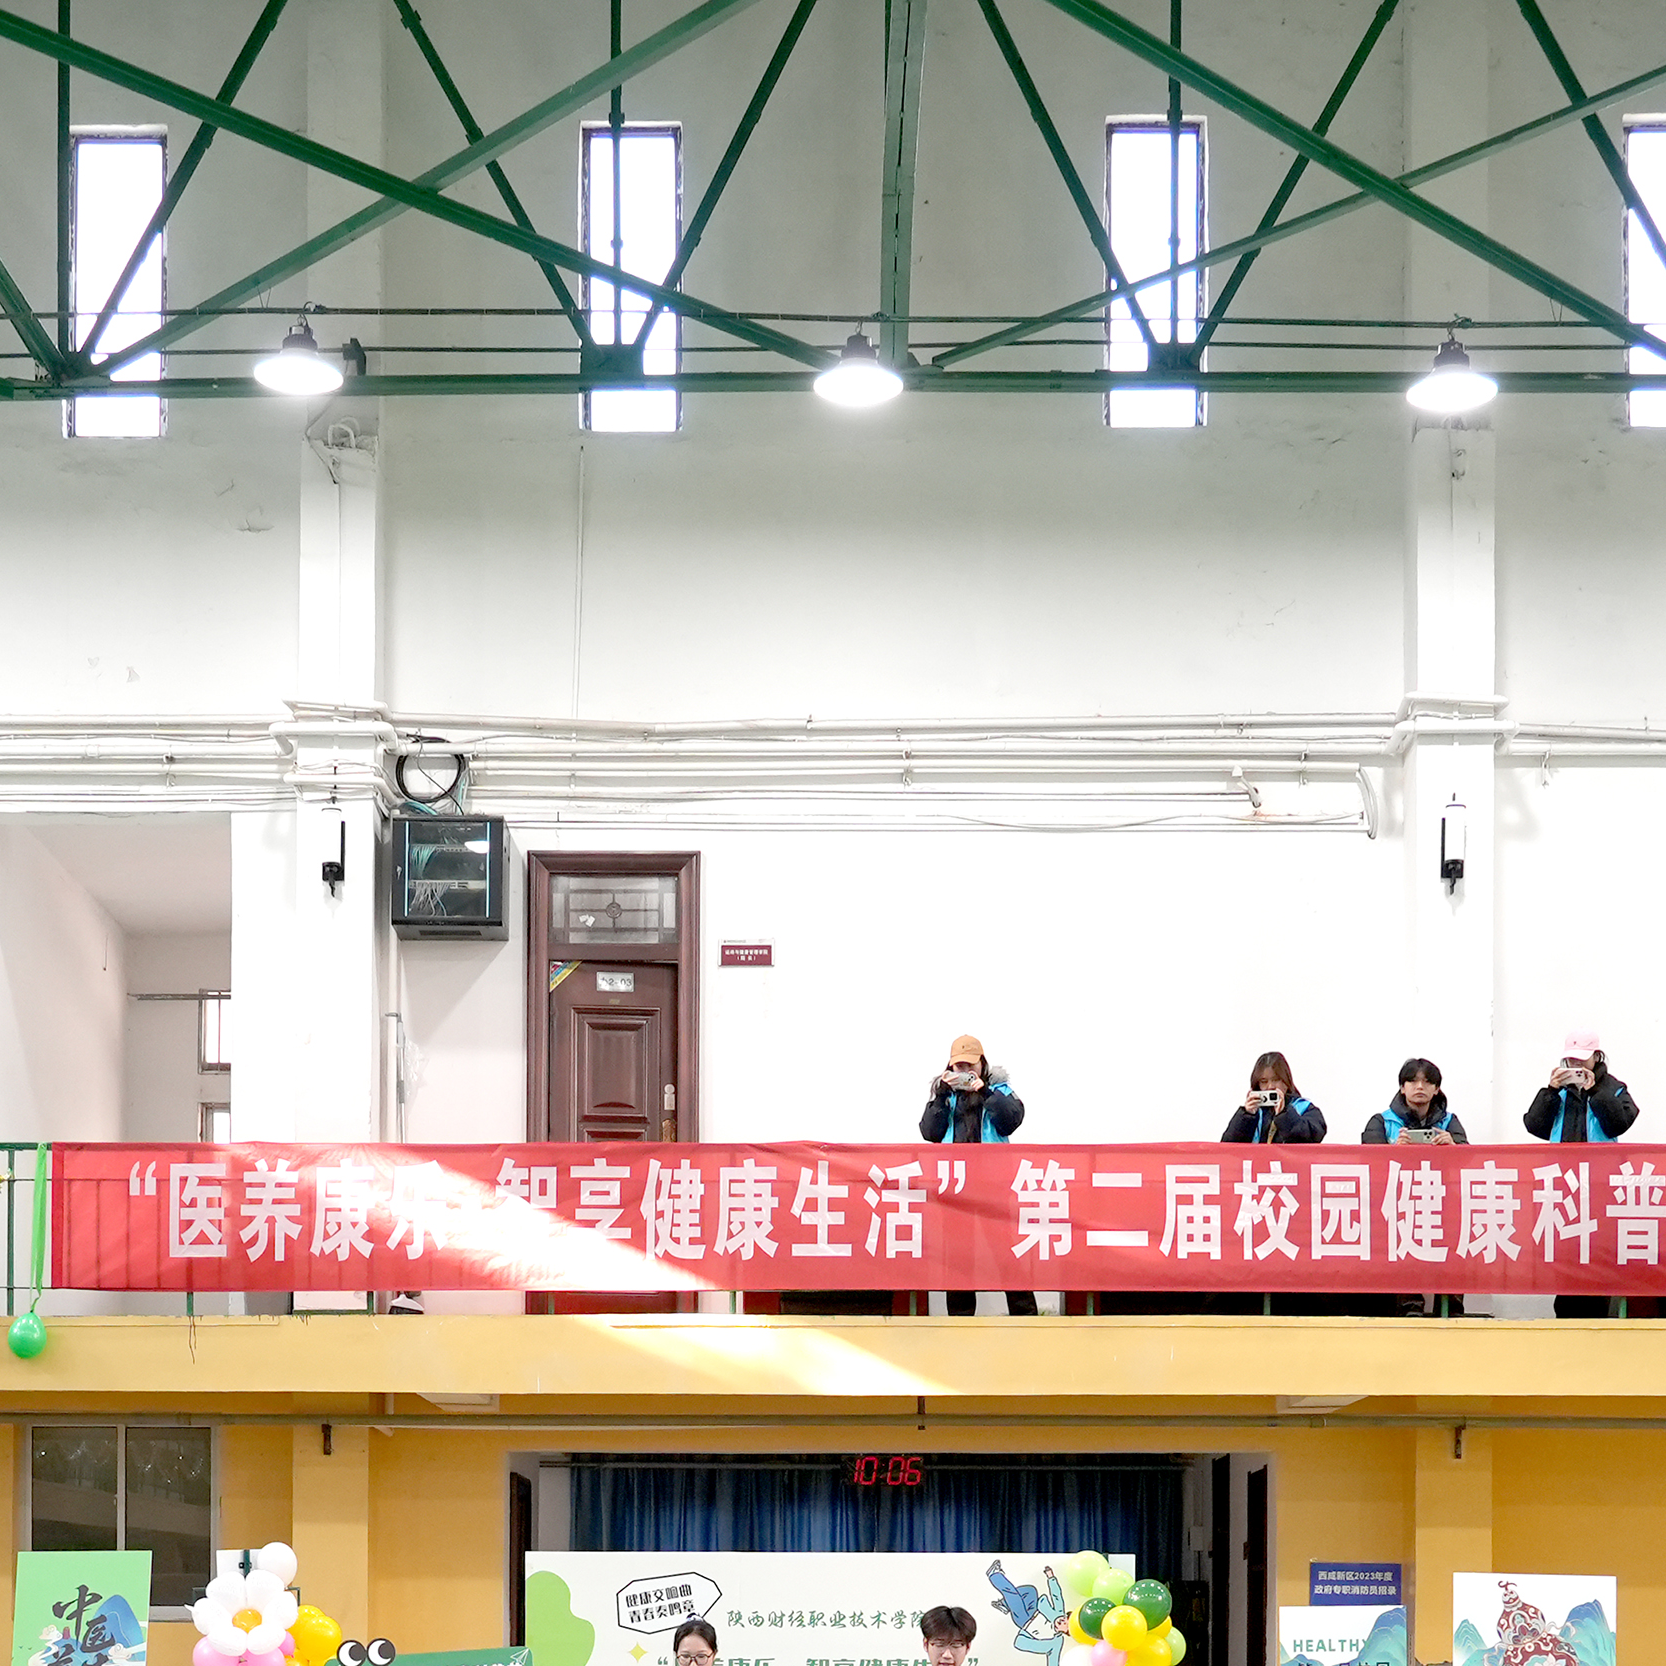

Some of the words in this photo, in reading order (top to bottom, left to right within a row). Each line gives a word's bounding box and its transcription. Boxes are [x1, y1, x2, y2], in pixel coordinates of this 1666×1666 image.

[853, 1457, 922, 1485] 10:06
[1318, 1571, 1393, 1581] 西咸新区2023年度
[626, 1584, 692, 1608] 健康交响曲
[1314, 1585, 1397, 1595] 政府专职消防员招录
[1293, 1639, 1369, 1653] HEALTHY
